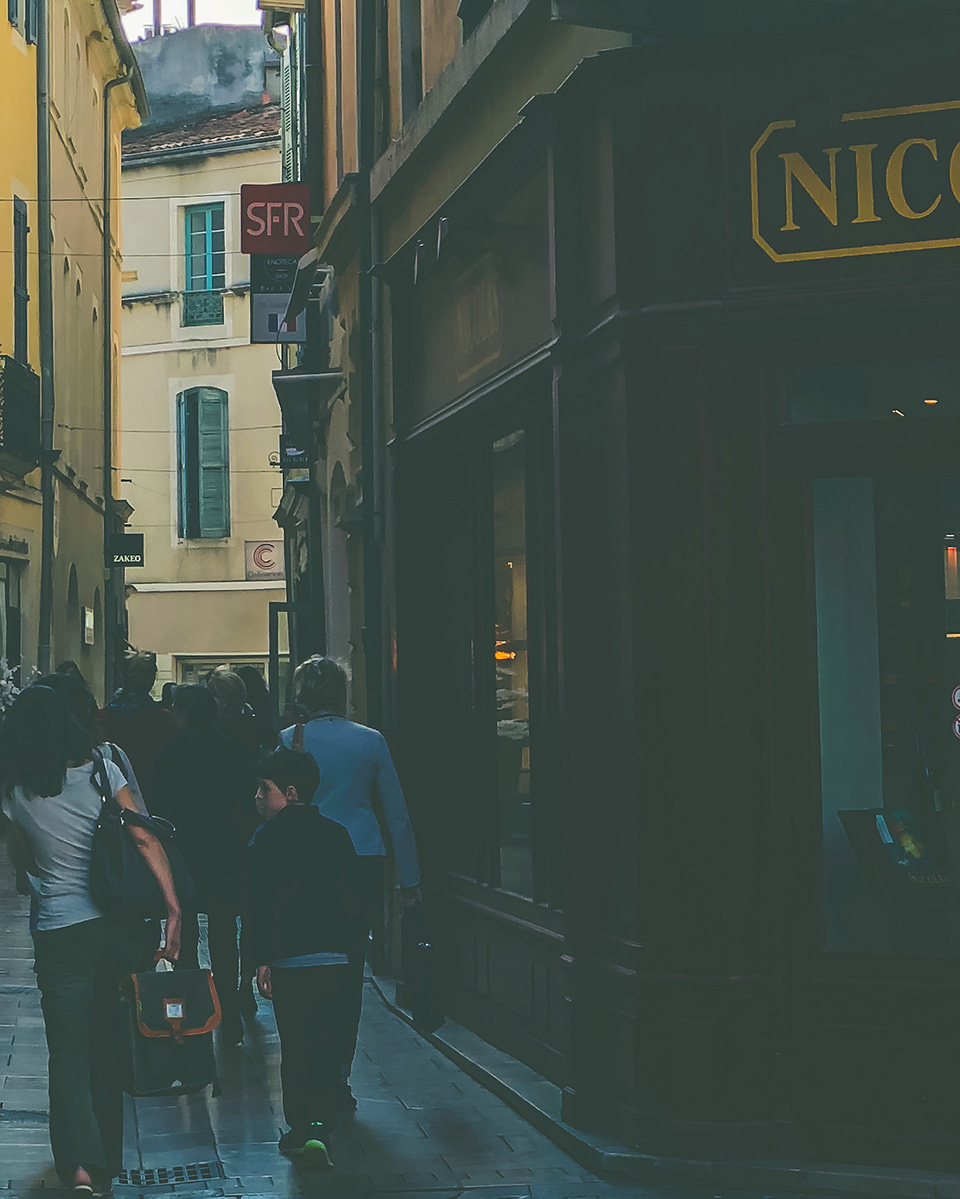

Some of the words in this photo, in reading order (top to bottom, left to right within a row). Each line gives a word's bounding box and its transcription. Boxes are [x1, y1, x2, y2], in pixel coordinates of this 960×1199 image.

[777, 137, 960, 231] NIC
[246, 202, 304, 237] SFR
[113, 555, 141, 563] ZAKEO
